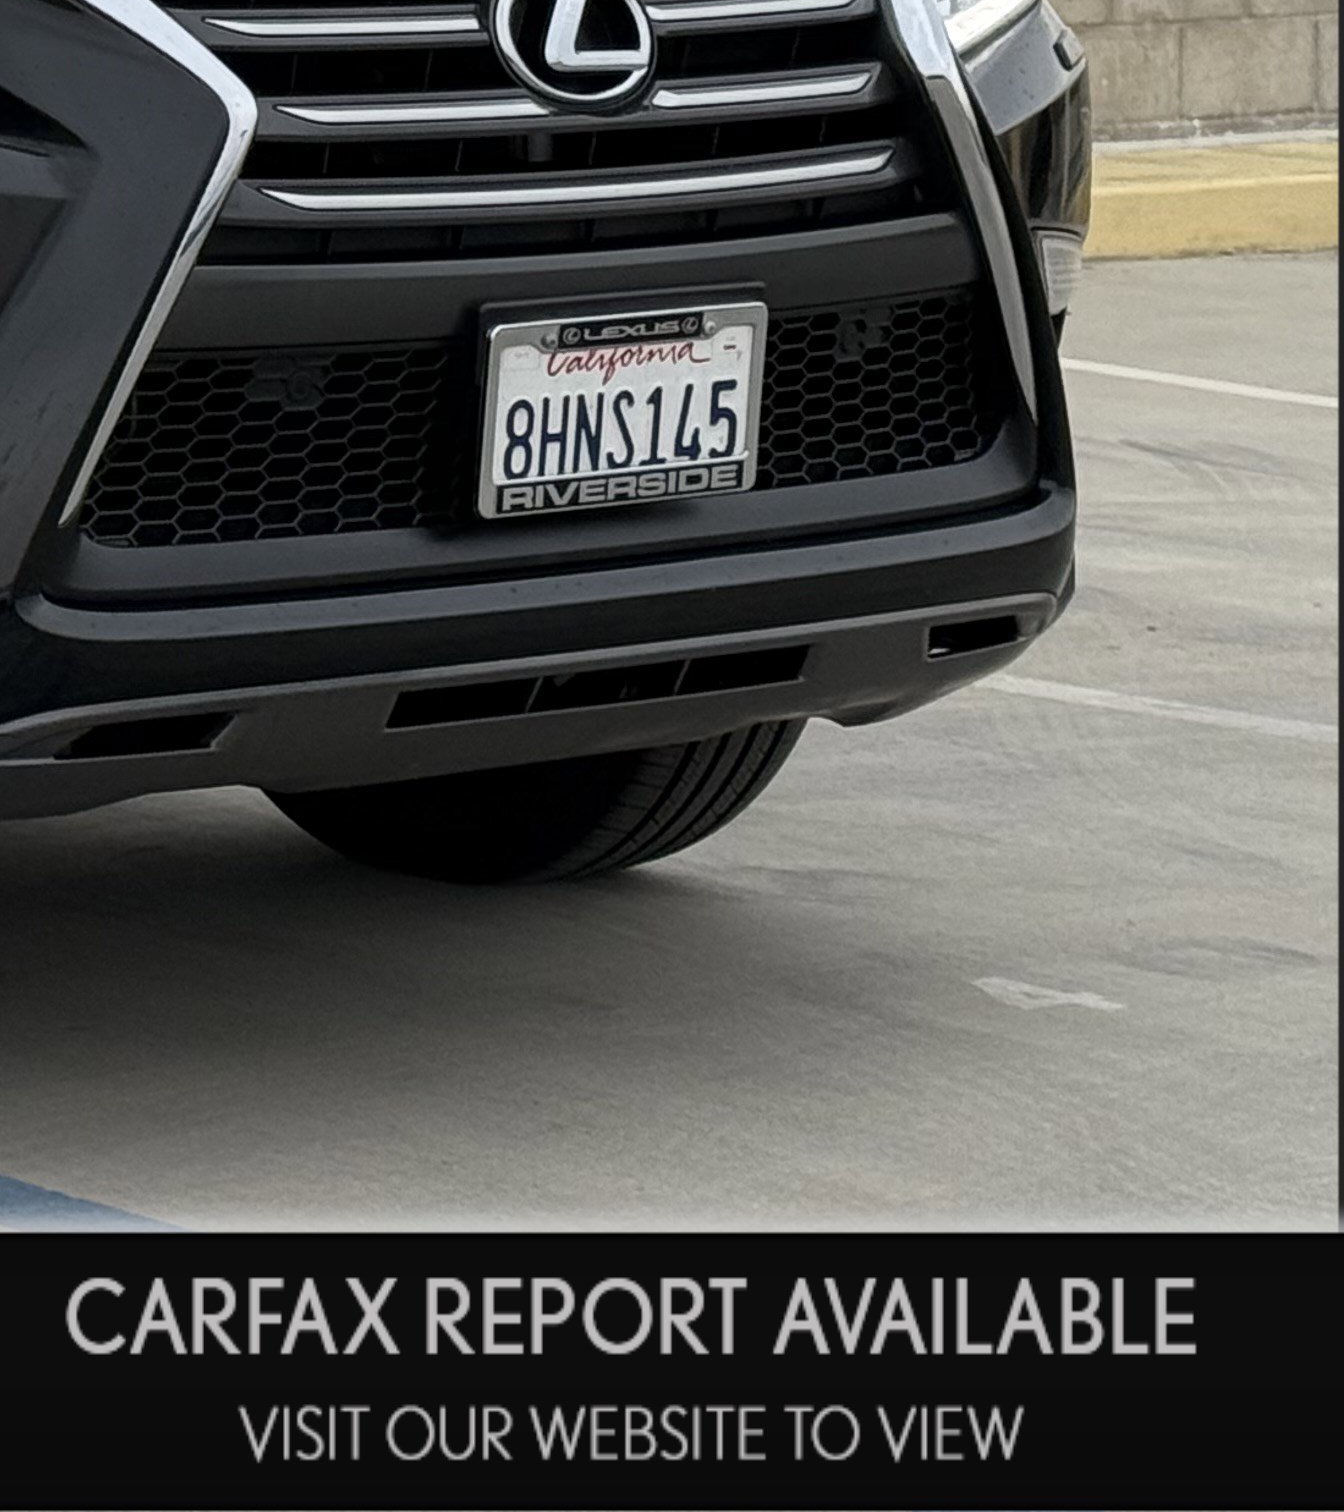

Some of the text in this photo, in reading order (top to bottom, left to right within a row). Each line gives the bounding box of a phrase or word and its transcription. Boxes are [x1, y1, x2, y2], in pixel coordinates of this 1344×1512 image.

[583, 320, 681, 341] LEXUS
[547, 342, 711, 386] California
[503, 379, 739, 480] 8HNS145
[501, 464, 740, 512] RIVERSIDE
